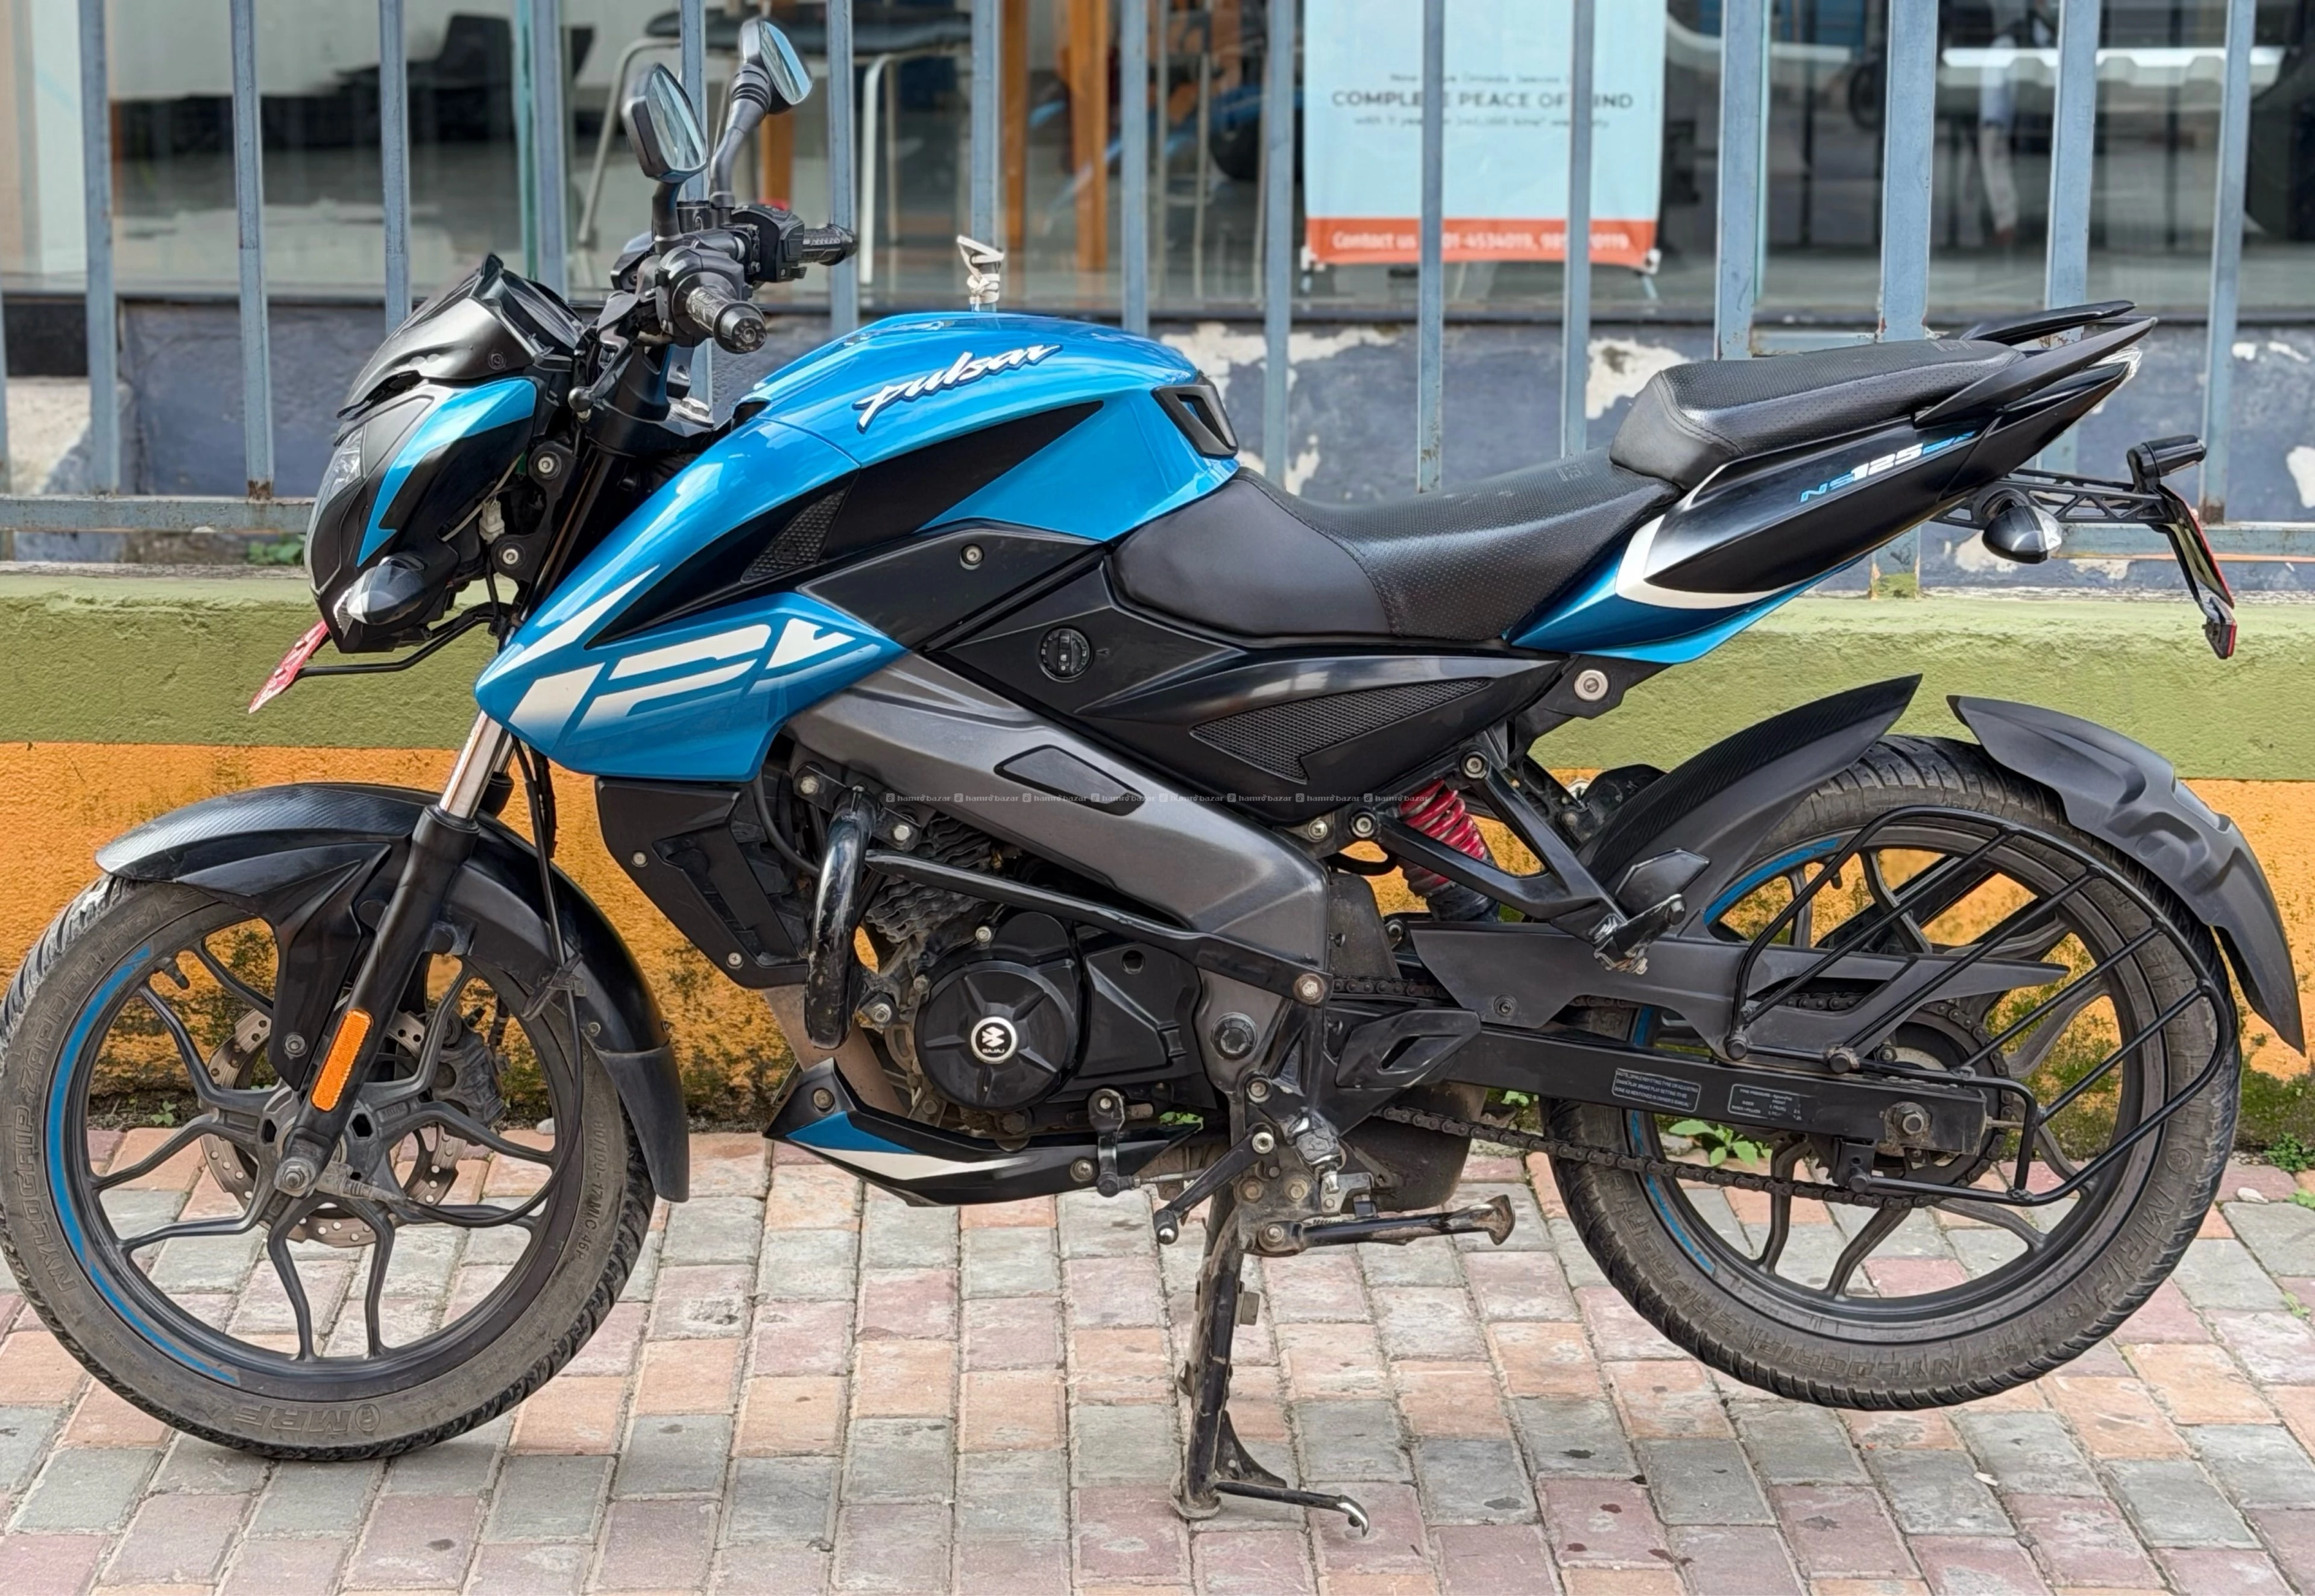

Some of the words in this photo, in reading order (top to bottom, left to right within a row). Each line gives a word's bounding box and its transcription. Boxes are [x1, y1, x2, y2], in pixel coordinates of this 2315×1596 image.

[1331, 90, 1449, 109] COMPLEE
[1459, 92, 1530, 108] PEACE
[1539, 92, 1567, 108] OF
[1332, 231, 1394, 250] Contact
[235, 1405, 351, 1433] MRF
